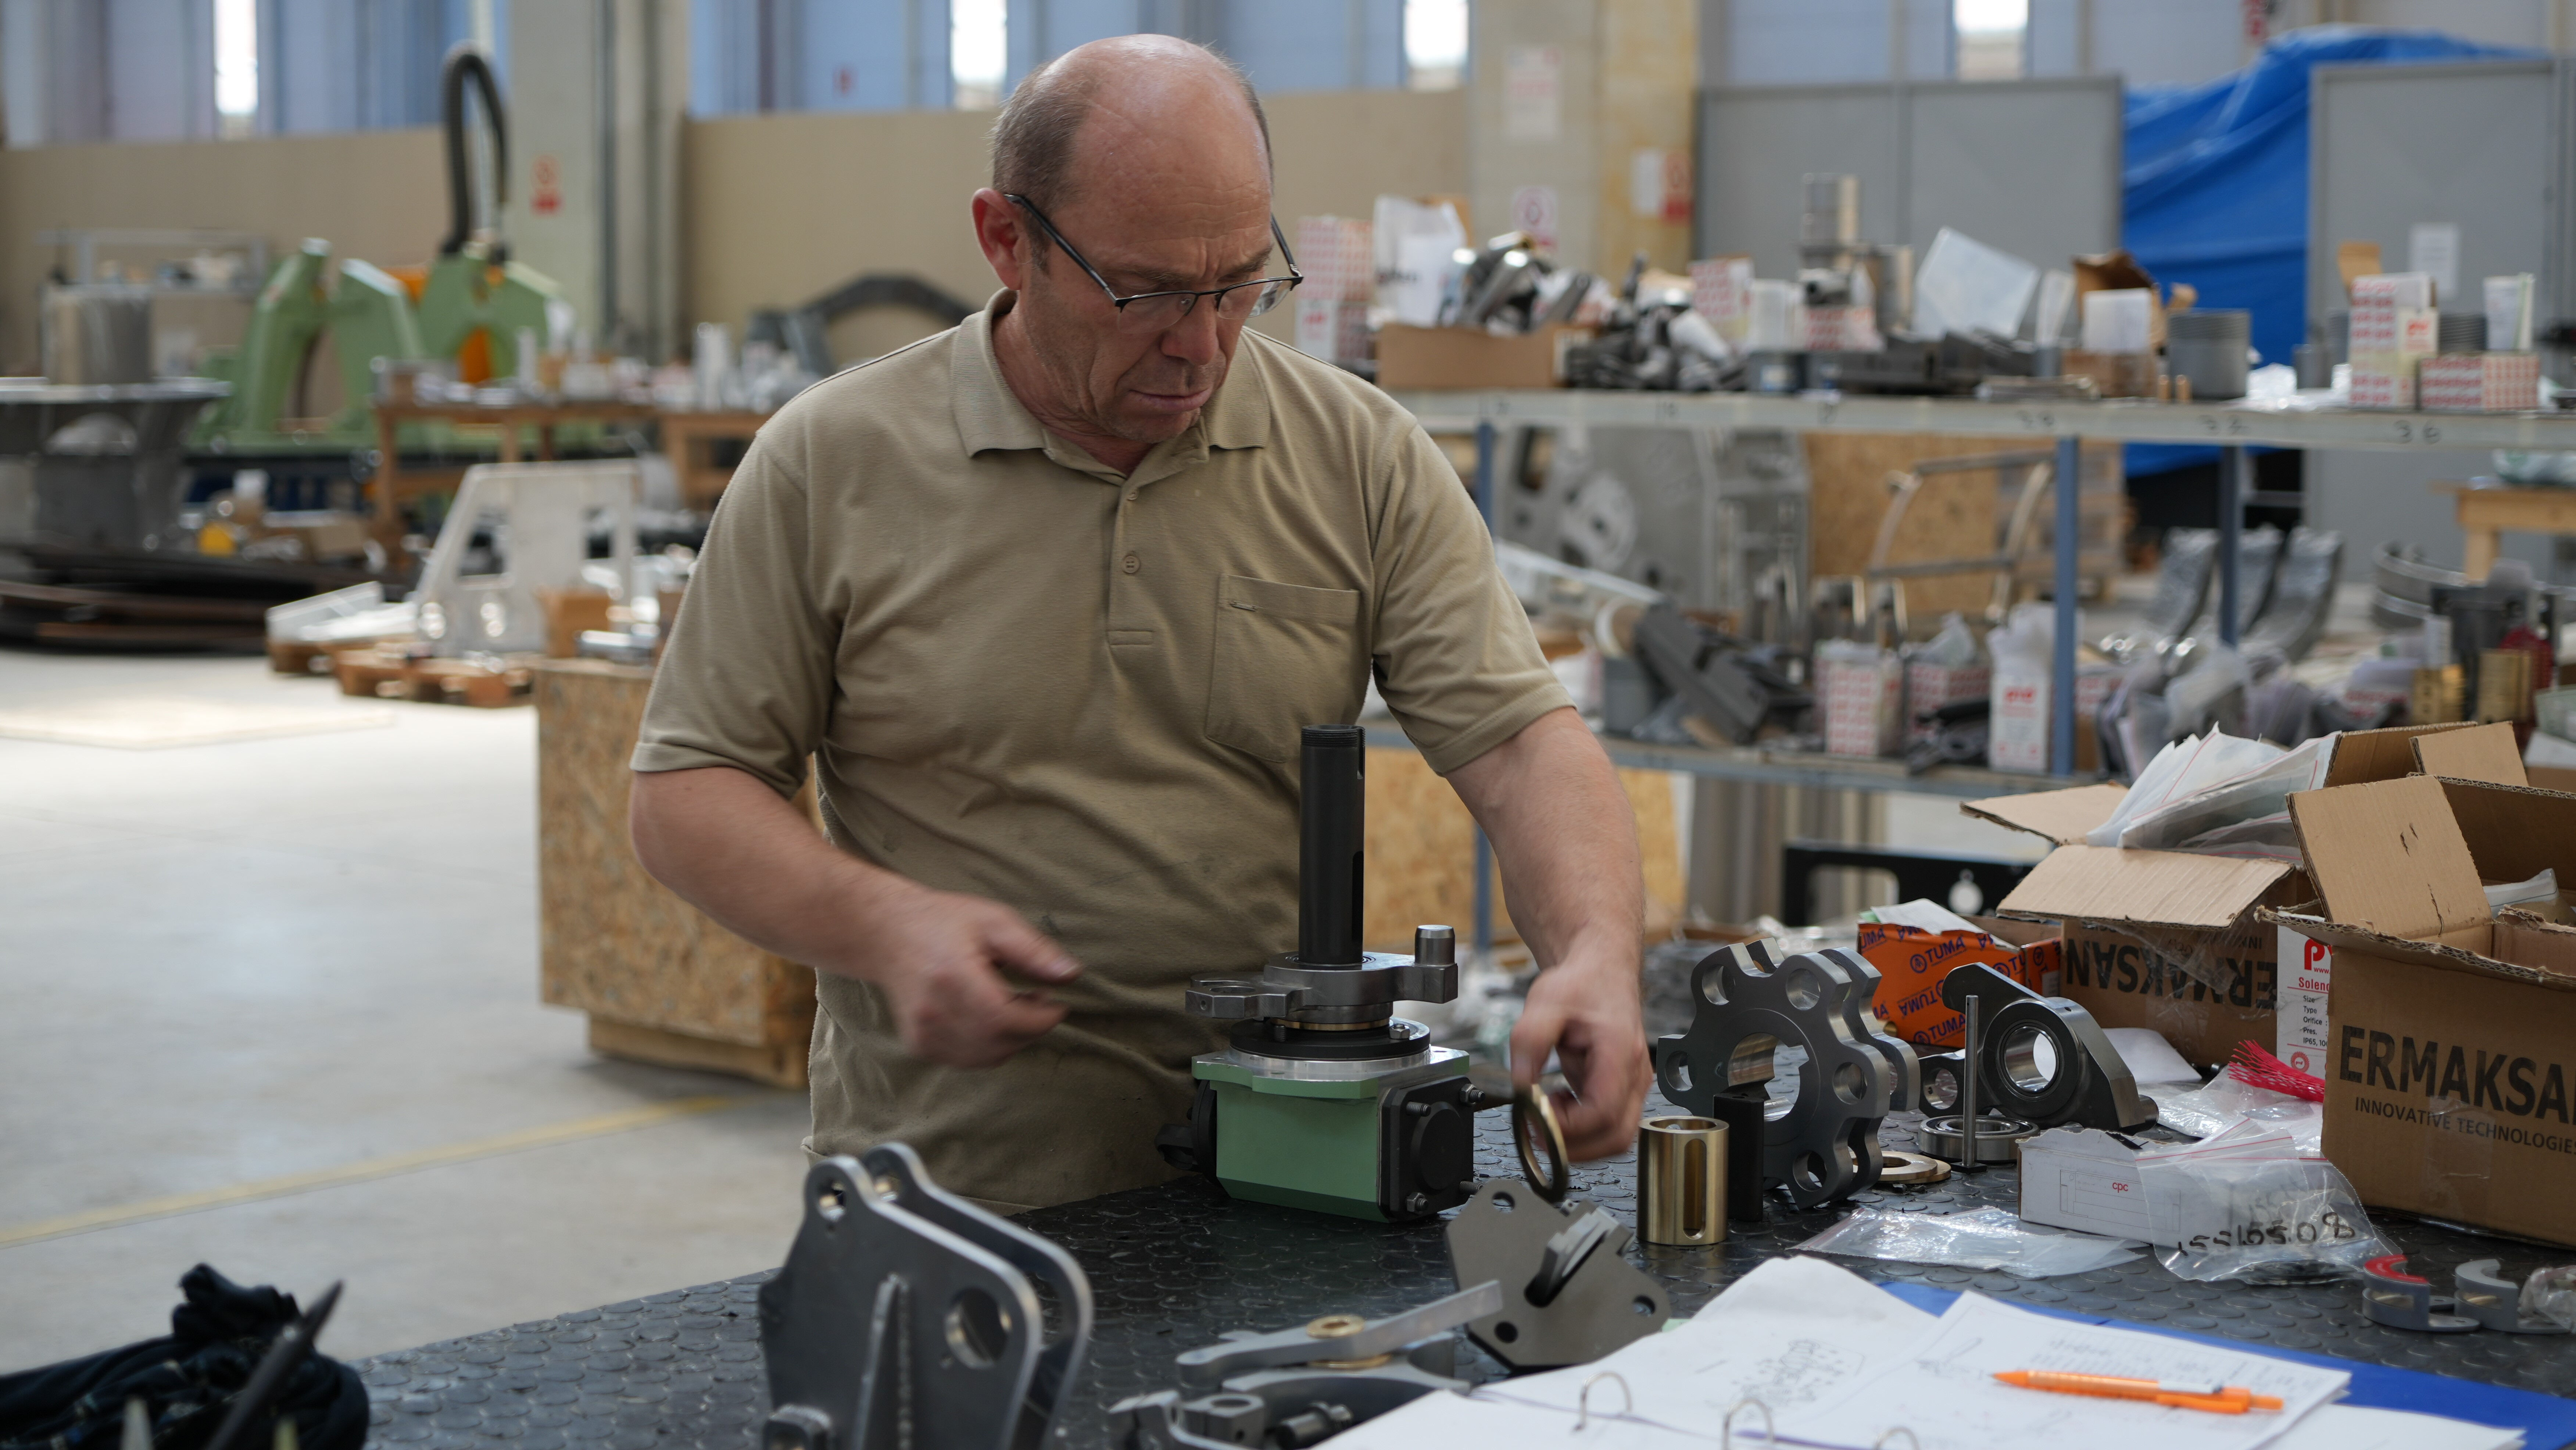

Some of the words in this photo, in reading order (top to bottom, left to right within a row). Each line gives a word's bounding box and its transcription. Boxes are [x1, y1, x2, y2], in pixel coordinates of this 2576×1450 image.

[1925, 936, 1965, 963] TUMA
[1898, 990, 1938, 1016] TUMA
[2303, 1006, 2317, 1014] Type
[1929, 1014, 1965, 1040] TUMA
[2303, 1016, 2322, 1025] Orifice
[2340, 1025, 2576, 1125] ERMAKSA
[2356, 1097, 2451, 1130] INNOVATIVE
[2112, 1182, 2128, 1193] cpc
